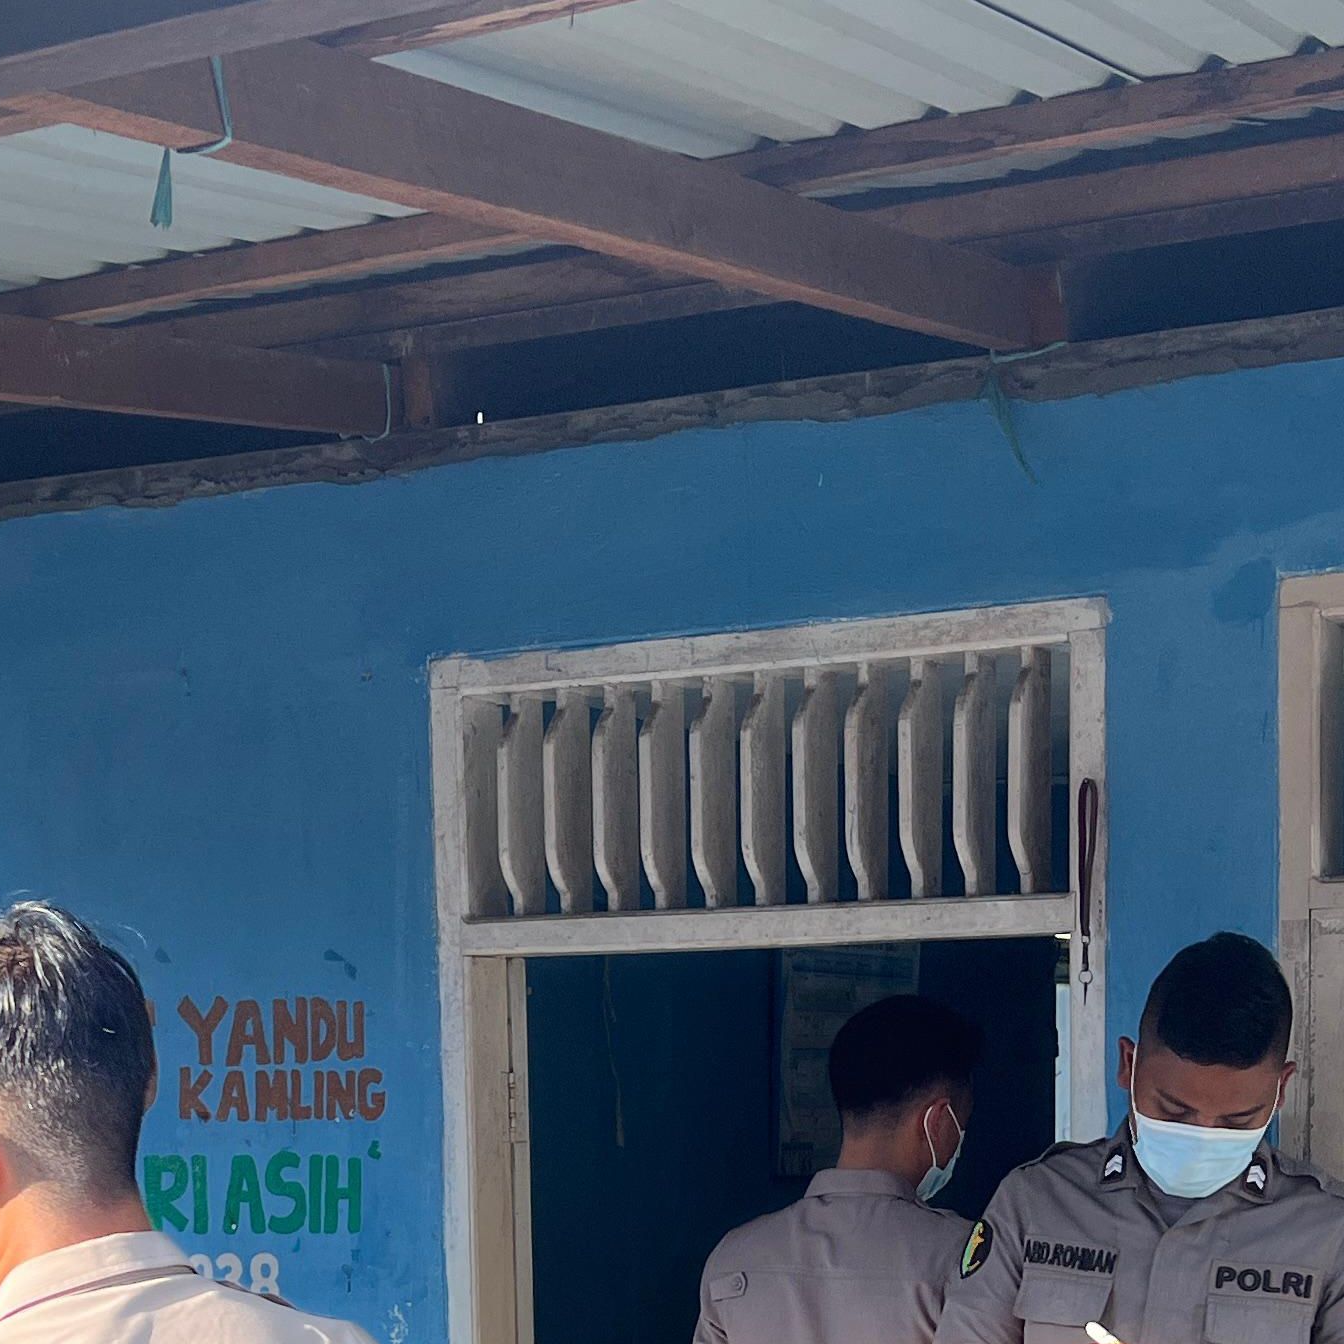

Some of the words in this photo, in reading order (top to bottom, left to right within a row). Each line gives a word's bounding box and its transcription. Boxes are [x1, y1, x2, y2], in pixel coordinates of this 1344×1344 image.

[177, 995, 364, 1066] YANDU
[179, 1067, 385, 1122] KAMLING
[1216, 1266, 1313, 1298] POLRI
